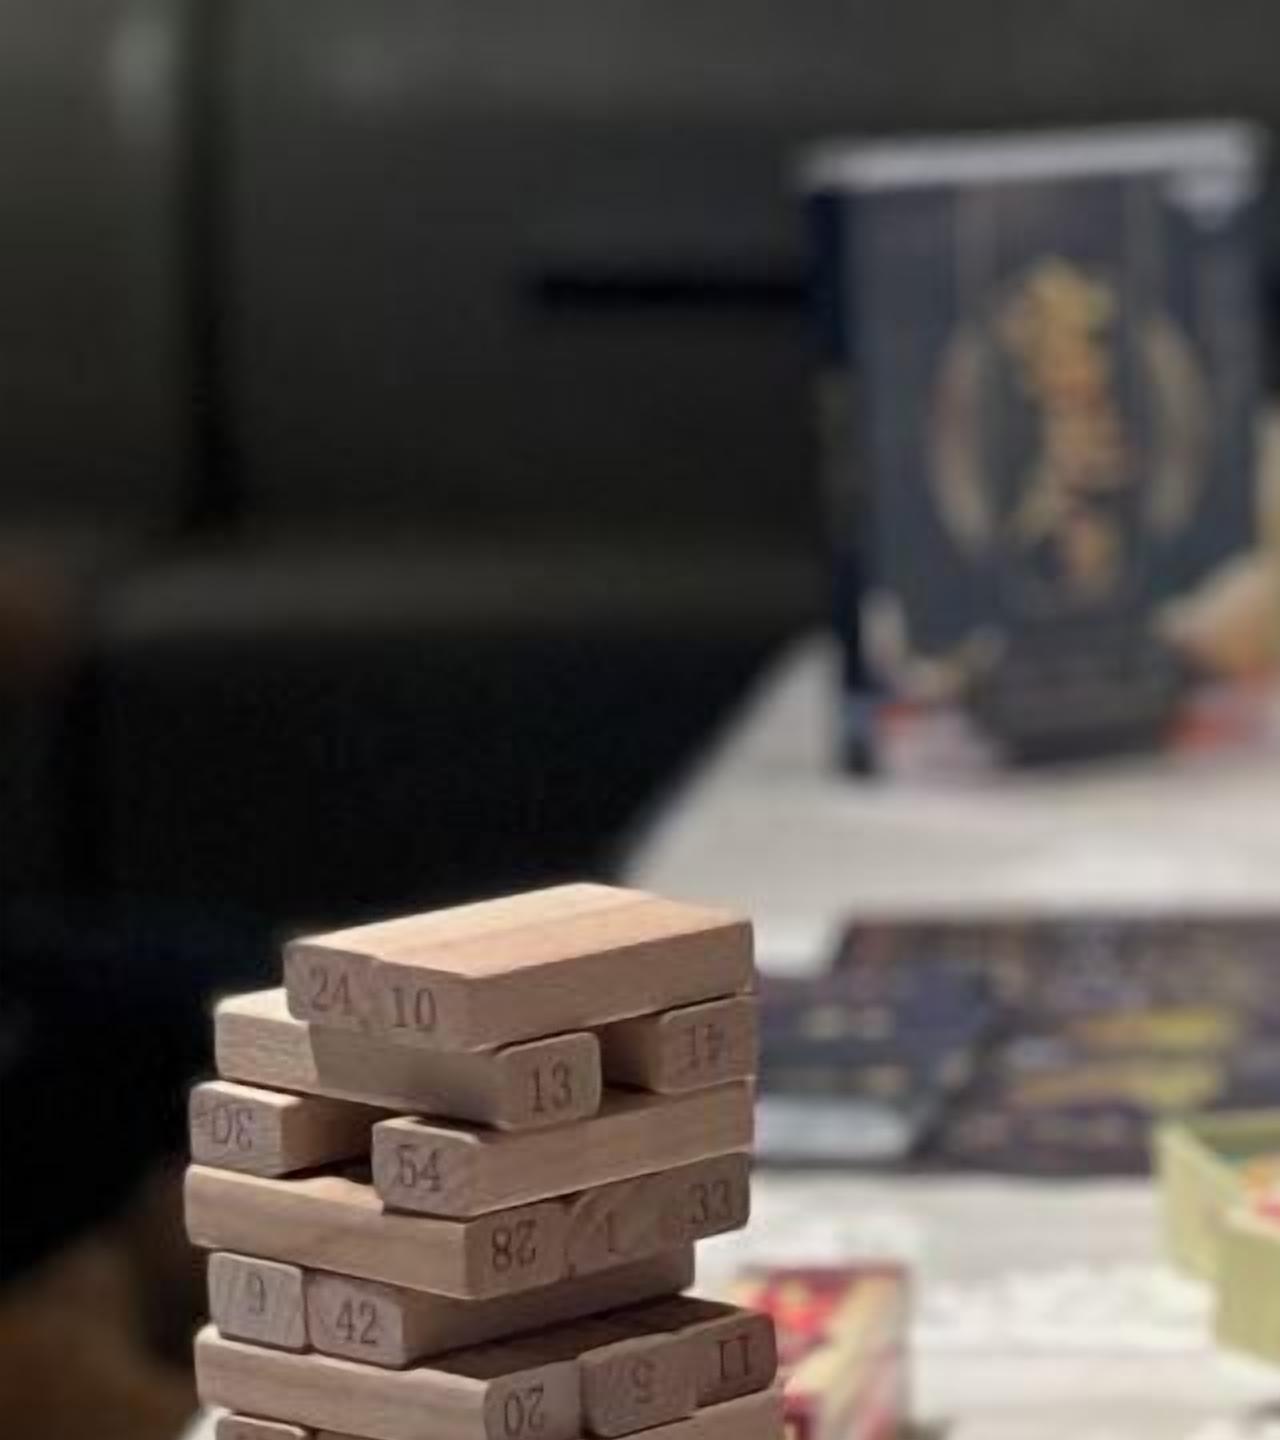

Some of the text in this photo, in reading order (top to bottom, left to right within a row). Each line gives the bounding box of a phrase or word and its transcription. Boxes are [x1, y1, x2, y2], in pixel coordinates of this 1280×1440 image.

[308, 966, 354, 1017] 24
[390, 986, 438, 1031] 10
[531, 1061, 573, 1114] 13
[491, 1219, 537, 1272] 28
[335, 1299, 377, 1346] 42
[503, 1382, 545, 1437] 20
